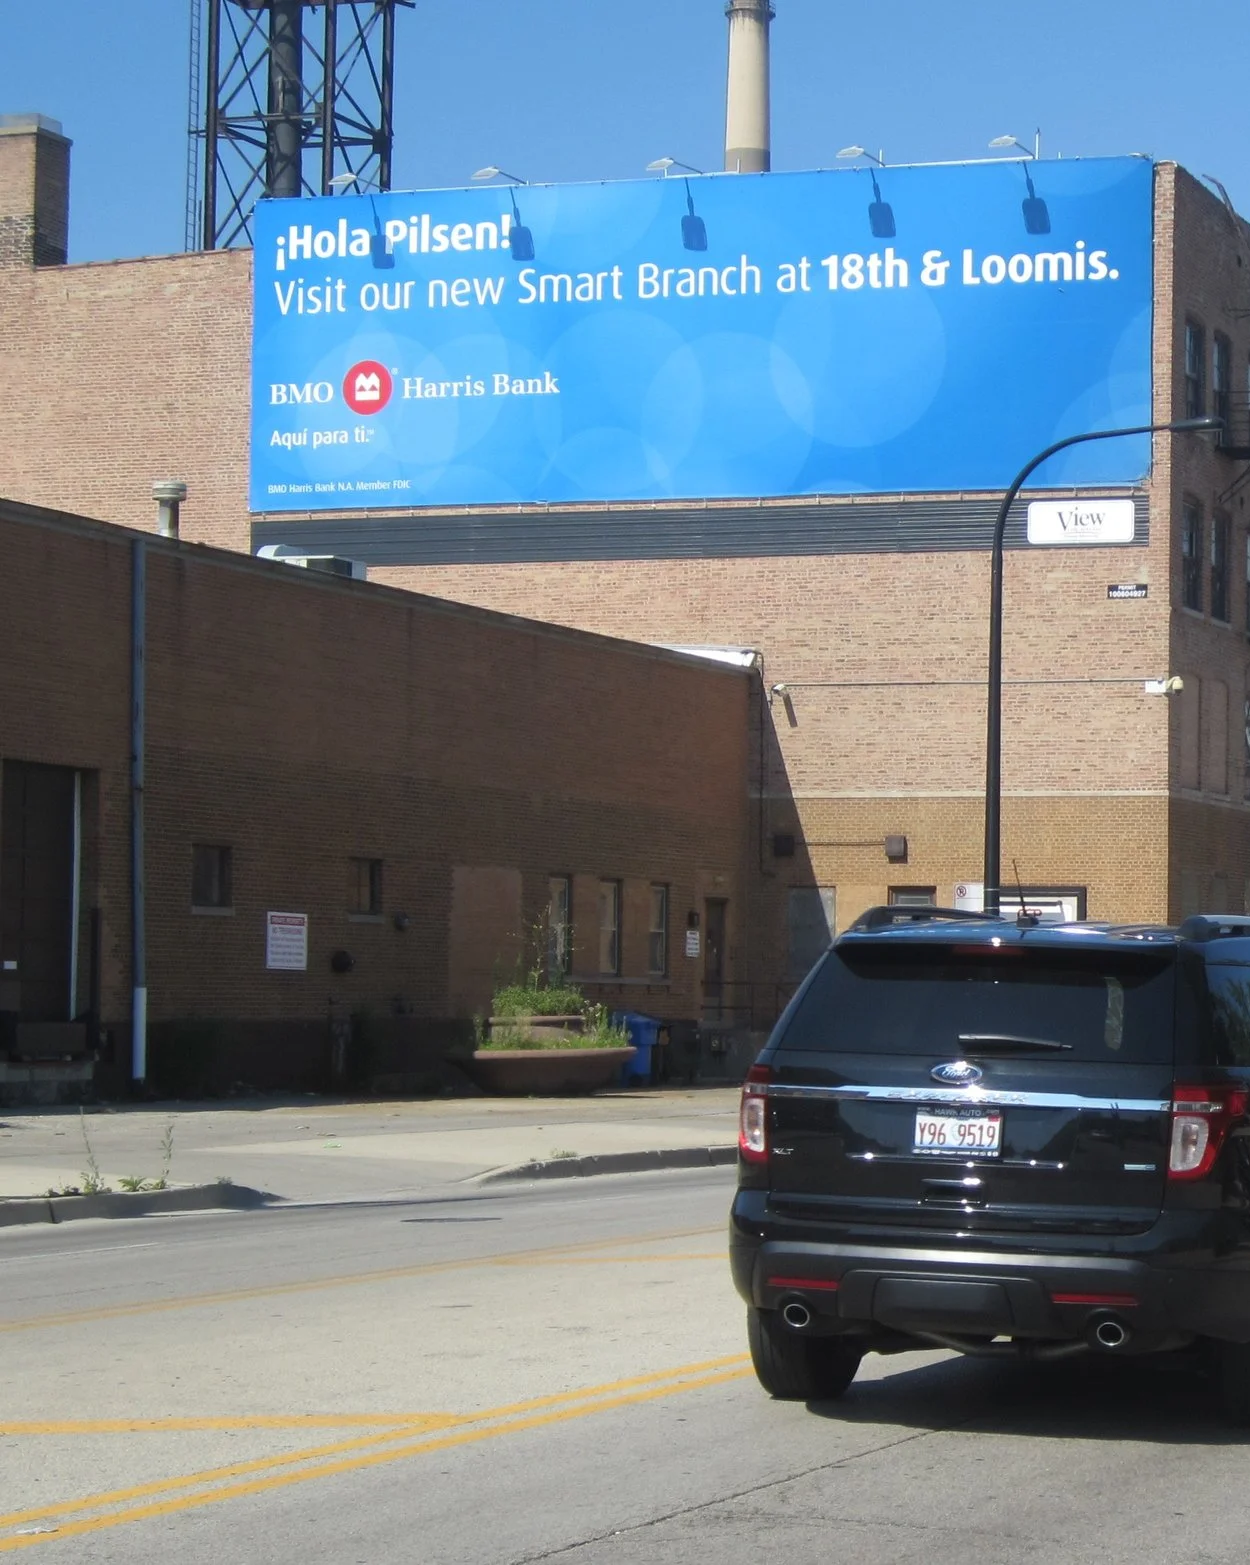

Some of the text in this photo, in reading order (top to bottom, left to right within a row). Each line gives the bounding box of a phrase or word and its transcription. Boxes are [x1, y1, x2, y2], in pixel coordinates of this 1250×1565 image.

[275, 214, 512, 271] ¡Hola Pilsen!
[274, 240, 1120, 315] Visit our new Smart Branch at 18th & Loomis.
[269, 371, 560, 405] BMO Harris Bank
[270, 428, 307, 450] Aquí
[312, 428, 349, 450] para
[267, 479, 412, 494] BMO Harris Bank N.A. Member FDIC
[1056, 506, 1106, 531] View
[960, 1109, 982, 1117] AUTO
[918, 1122, 996, 1147] Y96 9519
